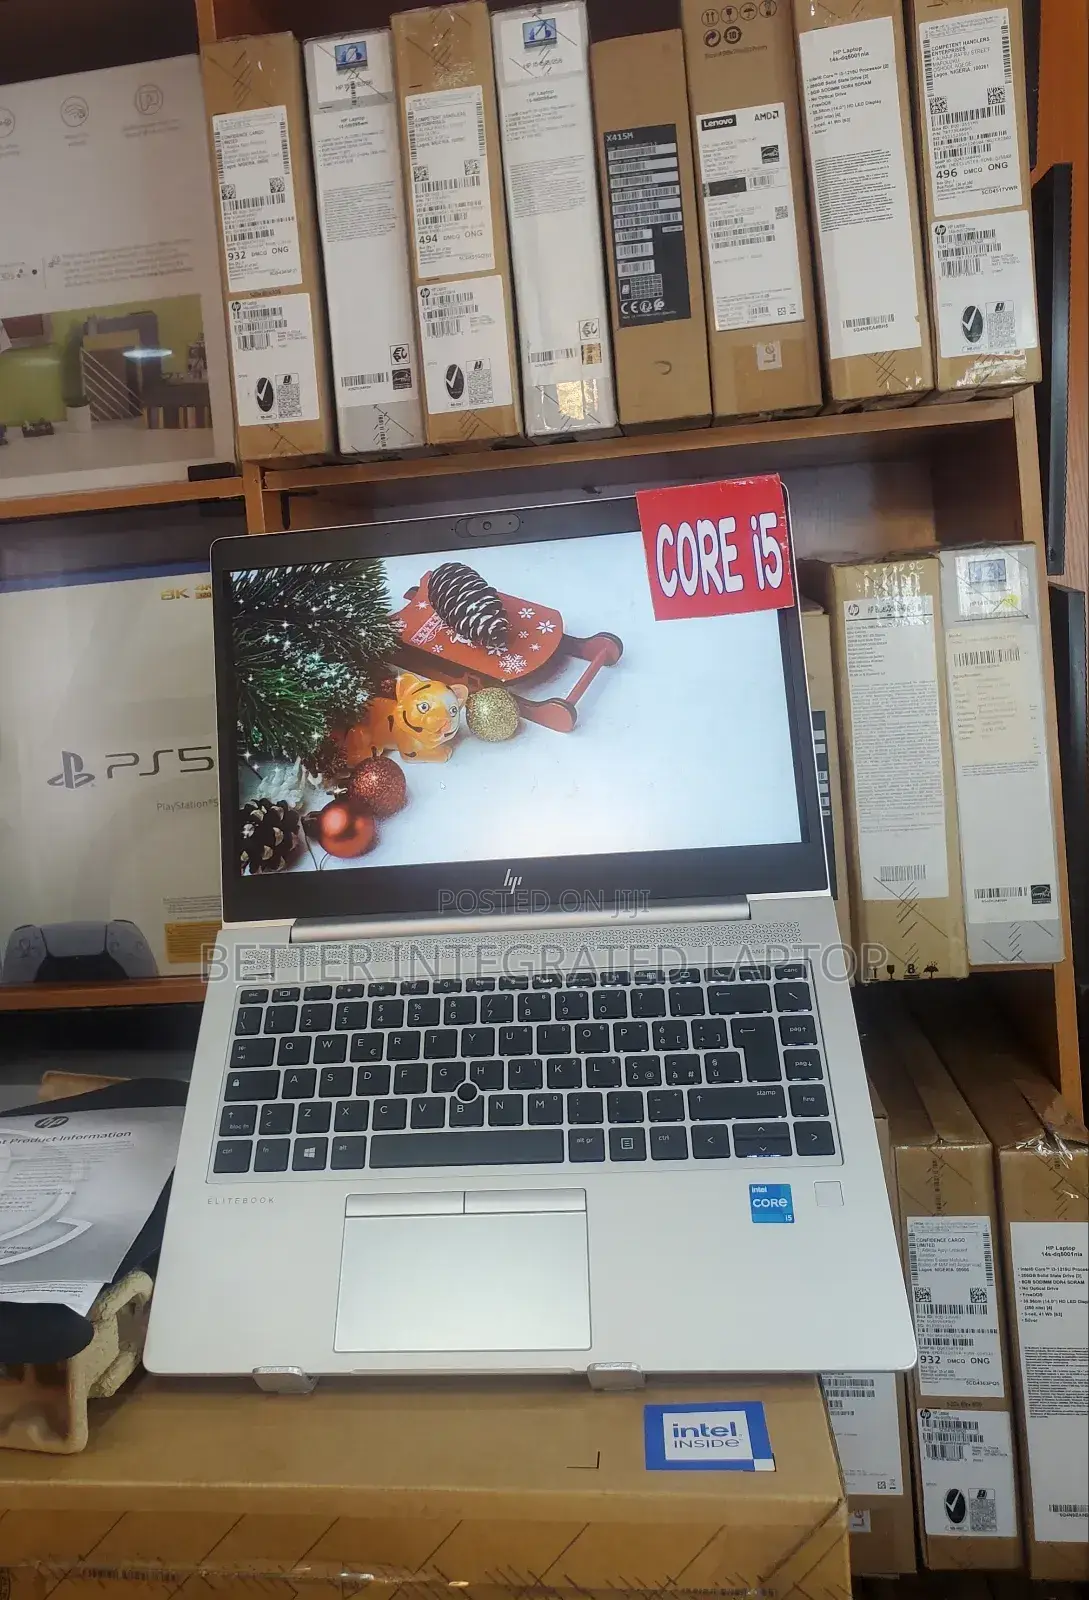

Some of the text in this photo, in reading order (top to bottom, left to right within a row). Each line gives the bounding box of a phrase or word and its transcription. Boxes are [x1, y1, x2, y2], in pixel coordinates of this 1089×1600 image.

[754, 111, 773, 121] AMD
[703, 117, 734, 129] Lenovo
[936, 168, 957, 178] 496
[988, 162, 1008, 171] ONG
[419, 234, 438, 244] 494
[464, 230, 483, 238] ONG
[228, 251, 246, 261] 932
[656, 512, 783, 598] CORE i5
[105, 746, 215, 779] PS5
[525, 1008, 531, 1016] 8
[562, 1007, 569, 1015] 9
[341, 1017, 347, 1025] 3
[377, 1015, 384, 1023] 4
[414, 1013, 420, 1021] 5
[468, 1034, 476, 1042] Y
[506, 1032, 513, 1040] U
[394, 1037, 401, 1045] R
[285, 1042, 294, 1050] Q
[440, 1068, 447, 1076] G
[477, 1067, 484, 1075] H
[515, 1066, 521, 1074] J
[554, 1065, 562, 1073] K
[594, 1064, 600, 1072] L
[327, 1074, 334, 1082] S
[364, 1072, 371, 1080] D
[401, 1070, 407, 1078] F
[645, 1071, 654, 1079] @
[290, 1075, 298, 1083] A
[419, 1104, 427, 1112] V
[457, 1105, 464, 1113] B
[496, 1102, 504, 1110] N
[536, 1101, 545, 1109] M
[304, 1109, 311, 1117] Z
[380, 1106, 387, 1114] C
[9, 1131, 132, 1145] Product Information
[207, 1197, 275, 1205] ELITEBOOK
[920, 1355, 940, 1364] 932
[672, 1422, 737, 1438] intel
